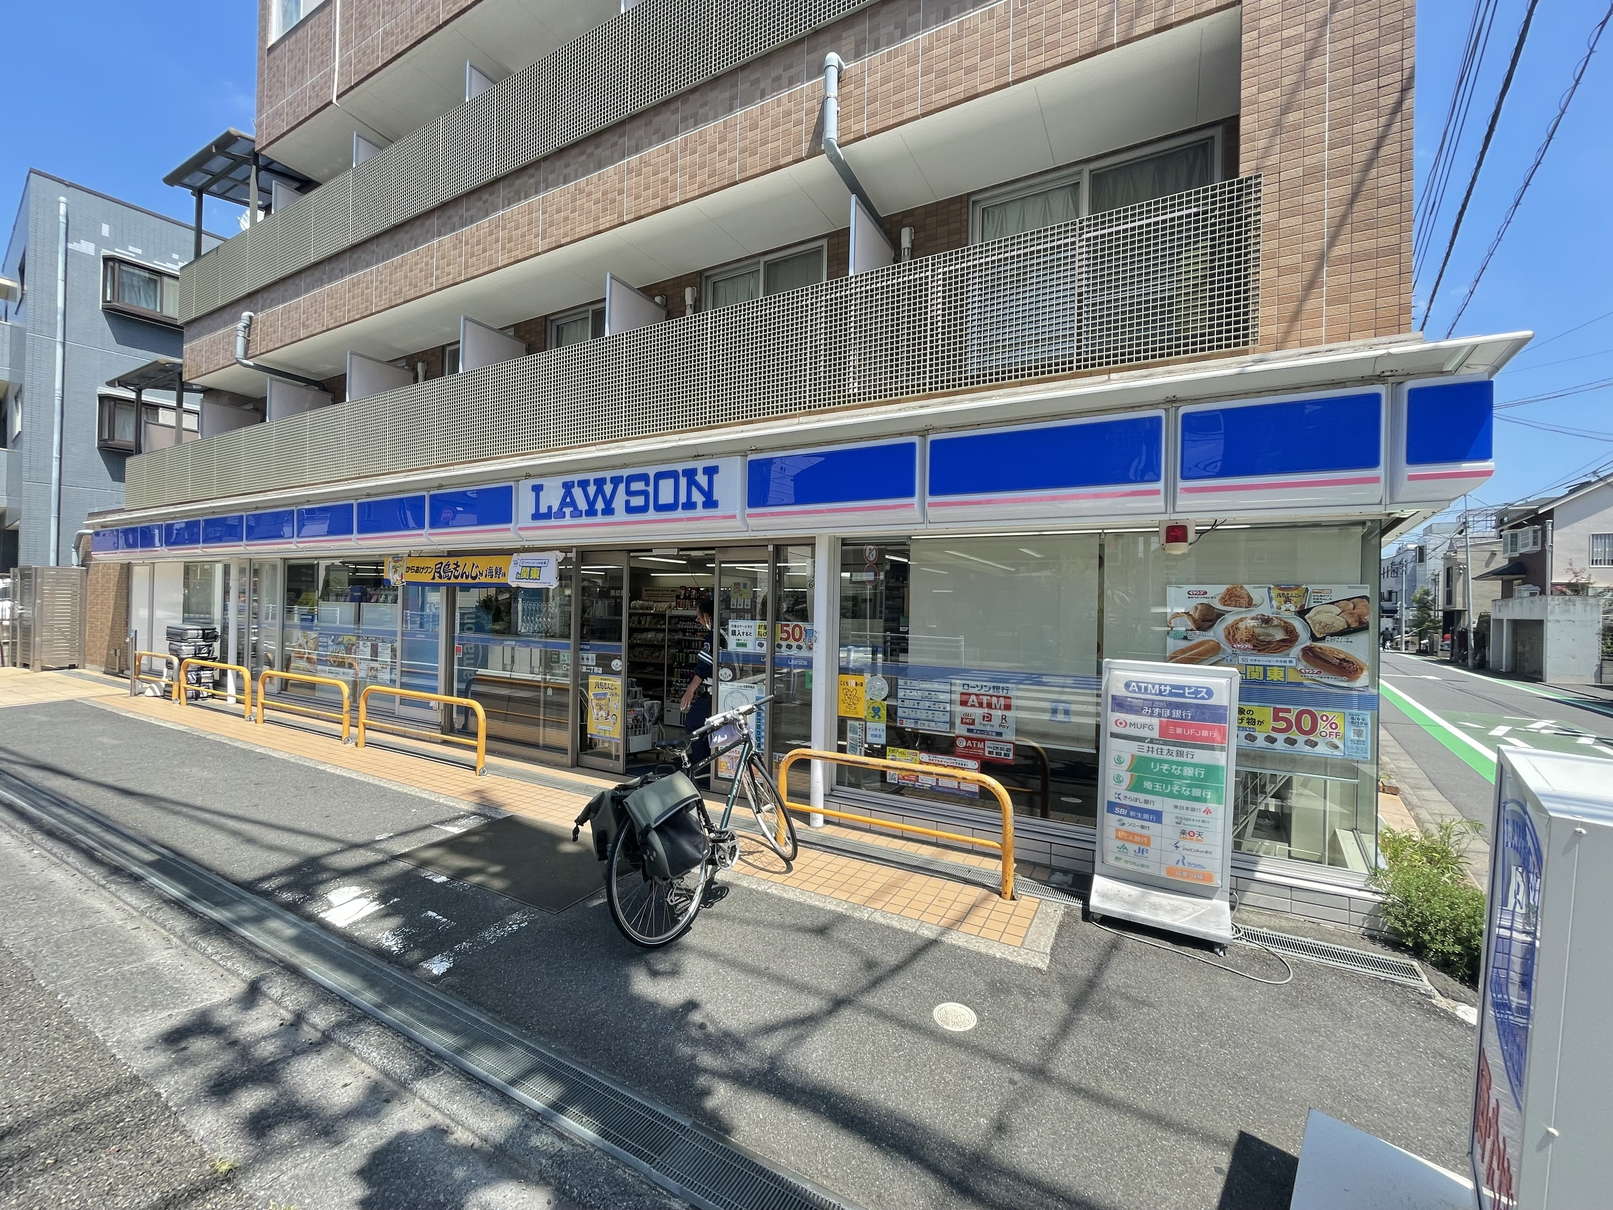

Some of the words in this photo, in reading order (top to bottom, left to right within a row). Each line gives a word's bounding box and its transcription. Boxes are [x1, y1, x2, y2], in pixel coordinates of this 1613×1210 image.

[531, 465, 719, 521] LAWSON
[405, 565, 433, 574] からあげクン
[779, 623, 806, 642] 50
[462, 613, 476, 680] amaon
[1247, 667, 1287, 682] 関東
[962, 683, 1010, 695] ローソン銀行
[1129, 682, 1209, 699] ATMサービス
[967, 695, 1005, 710] ATM
[1142, 706, 1192, 719] みずほ銀行
[1129, 722, 1154, 731] MUFG
[1319, 730, 1342, 739] OFF
[967, 740, 984, 748] ATM
[1136, 745, 1196, 759] 三井住友銀行
[1151, 761, 1206, 779] りそな銀行
[1143, 781, 1211, 799] 埼玉りそな銀行
